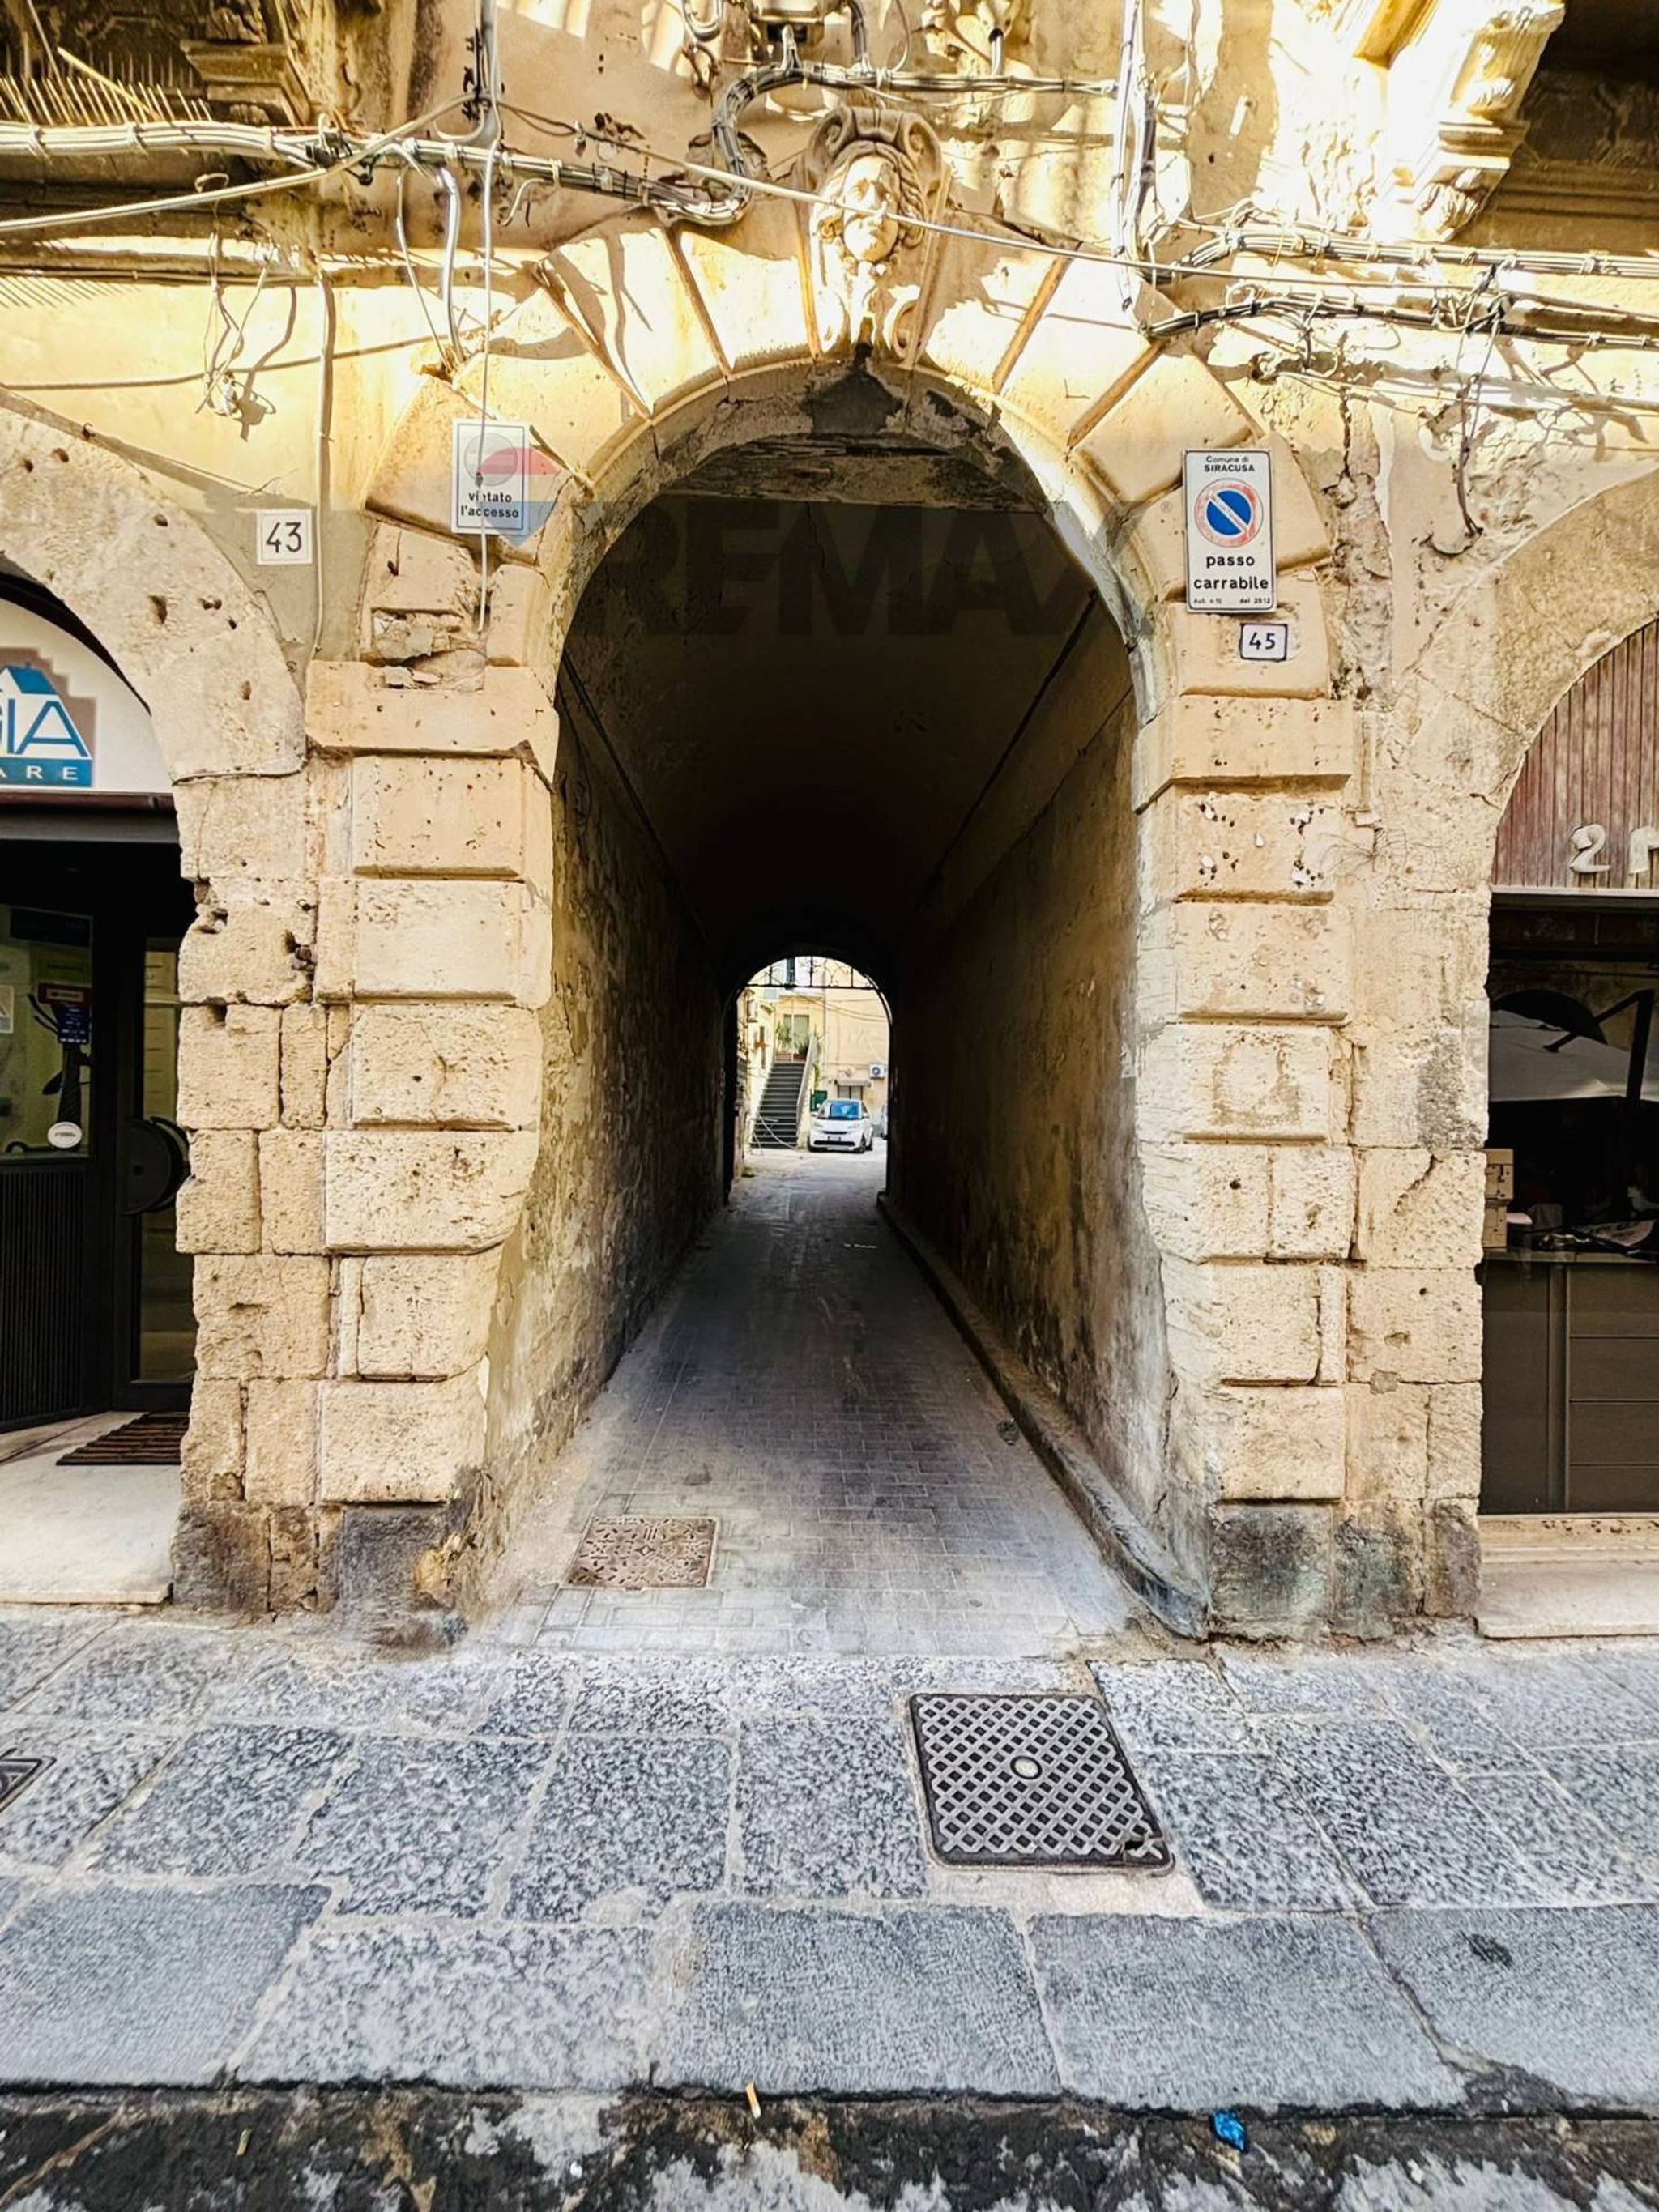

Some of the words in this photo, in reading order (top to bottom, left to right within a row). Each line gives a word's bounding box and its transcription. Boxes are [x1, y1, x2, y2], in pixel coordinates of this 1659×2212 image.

[1206, 455, 1239, 464] Comune
[1204, 464, 1255, 472] SIRACUSA
[460, 505, 519, 518] l'accesso
[266, 522, 302, 553] 43
[1206, 556, 1255, 569] passo
[1193, 576, 1269, 590] carrabile
[1249, 632, 1276, 650] 45
[0, 698, 88, 757] IA
